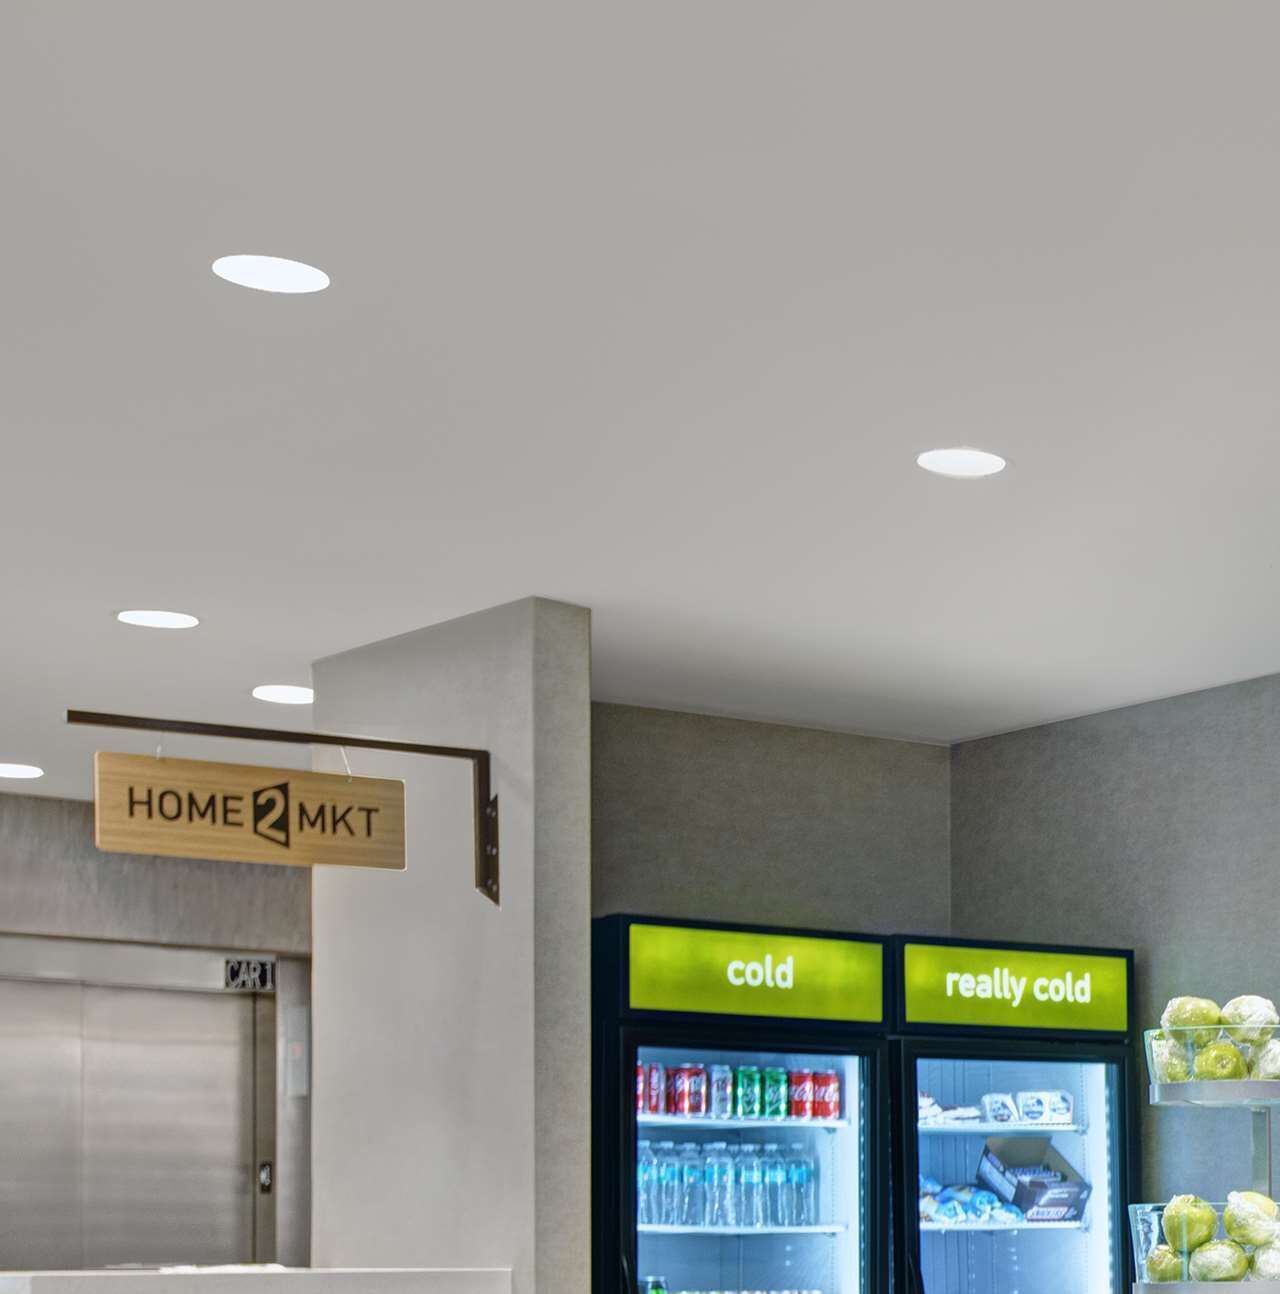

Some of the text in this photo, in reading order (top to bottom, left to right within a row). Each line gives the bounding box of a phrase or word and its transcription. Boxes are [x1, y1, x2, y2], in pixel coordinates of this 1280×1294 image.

[299, 801, 381, 838] MKT
[228, 959, 262, 990] CAR
[727, 954, 795, 989] cold
[946, 968, 1092, 1008] really cold
